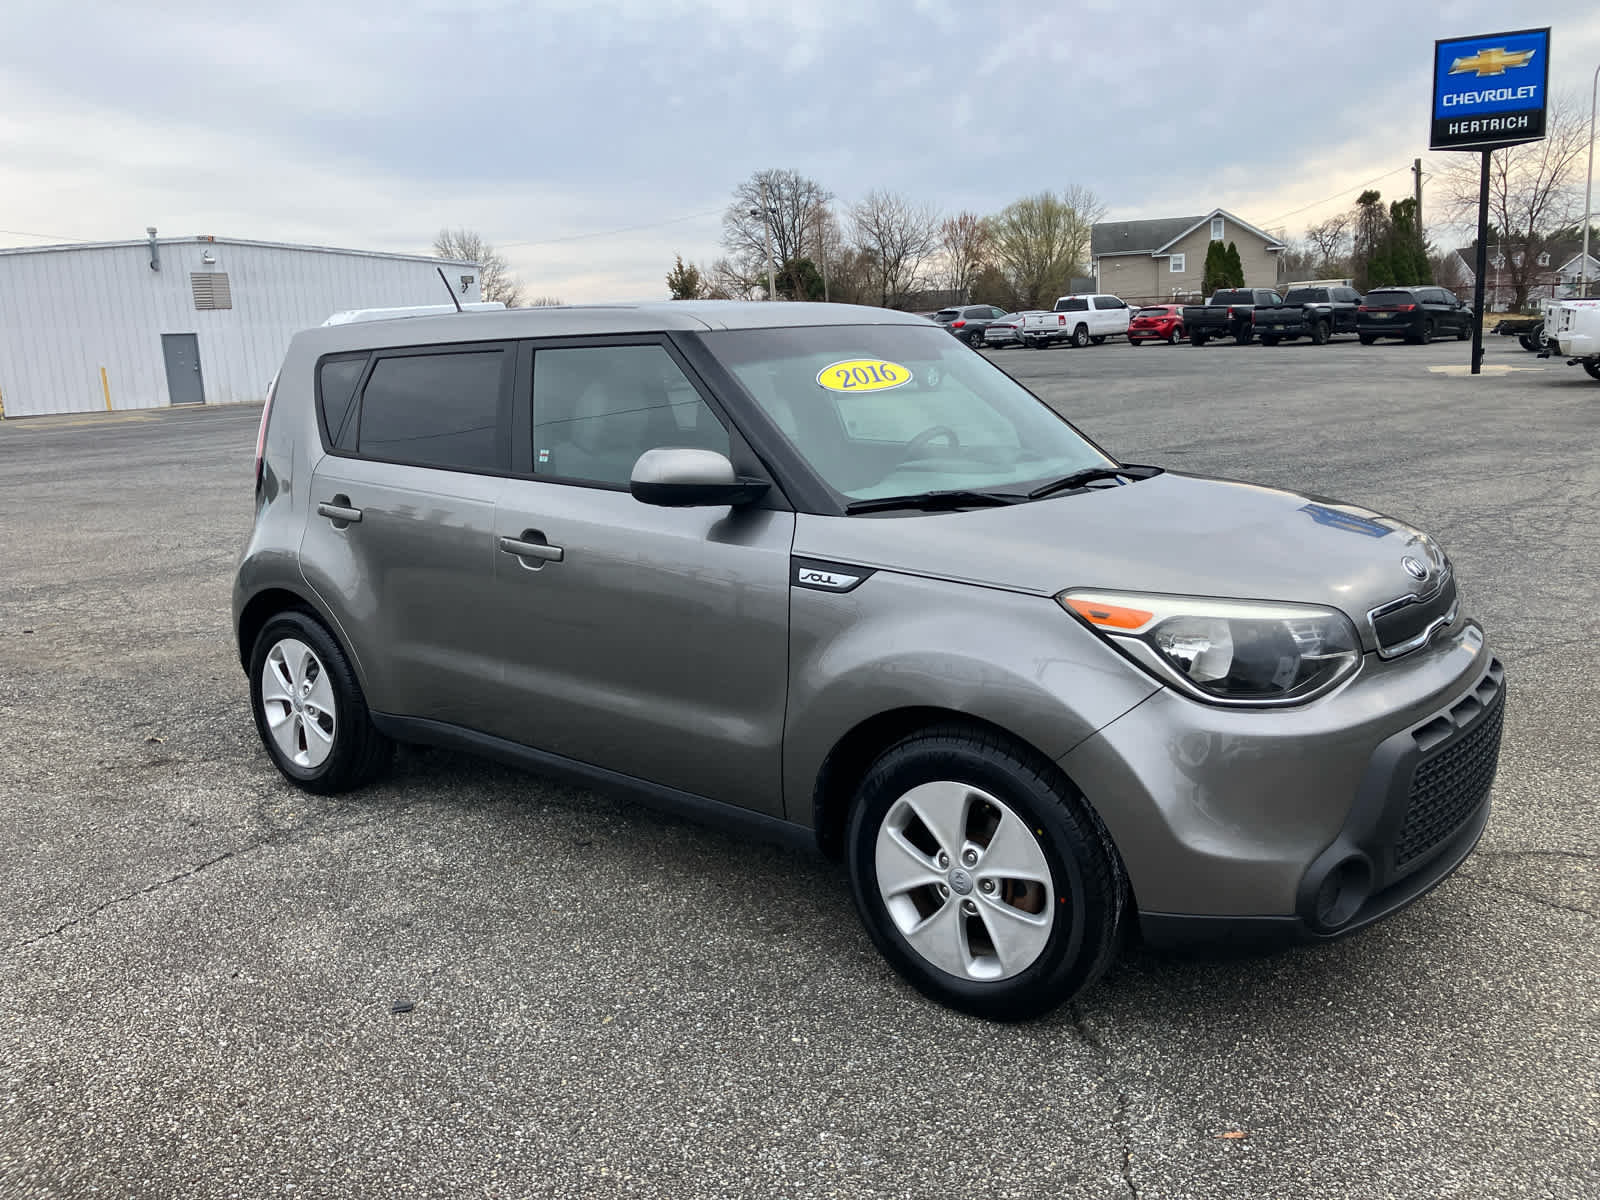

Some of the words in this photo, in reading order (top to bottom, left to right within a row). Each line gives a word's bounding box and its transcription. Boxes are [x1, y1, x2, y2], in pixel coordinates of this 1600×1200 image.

[1442, 85, 1537, 107] CHEVROLET
[1449, 115, 1528, 134] HERTRICH
[836, 363, 897, 388] 2016
